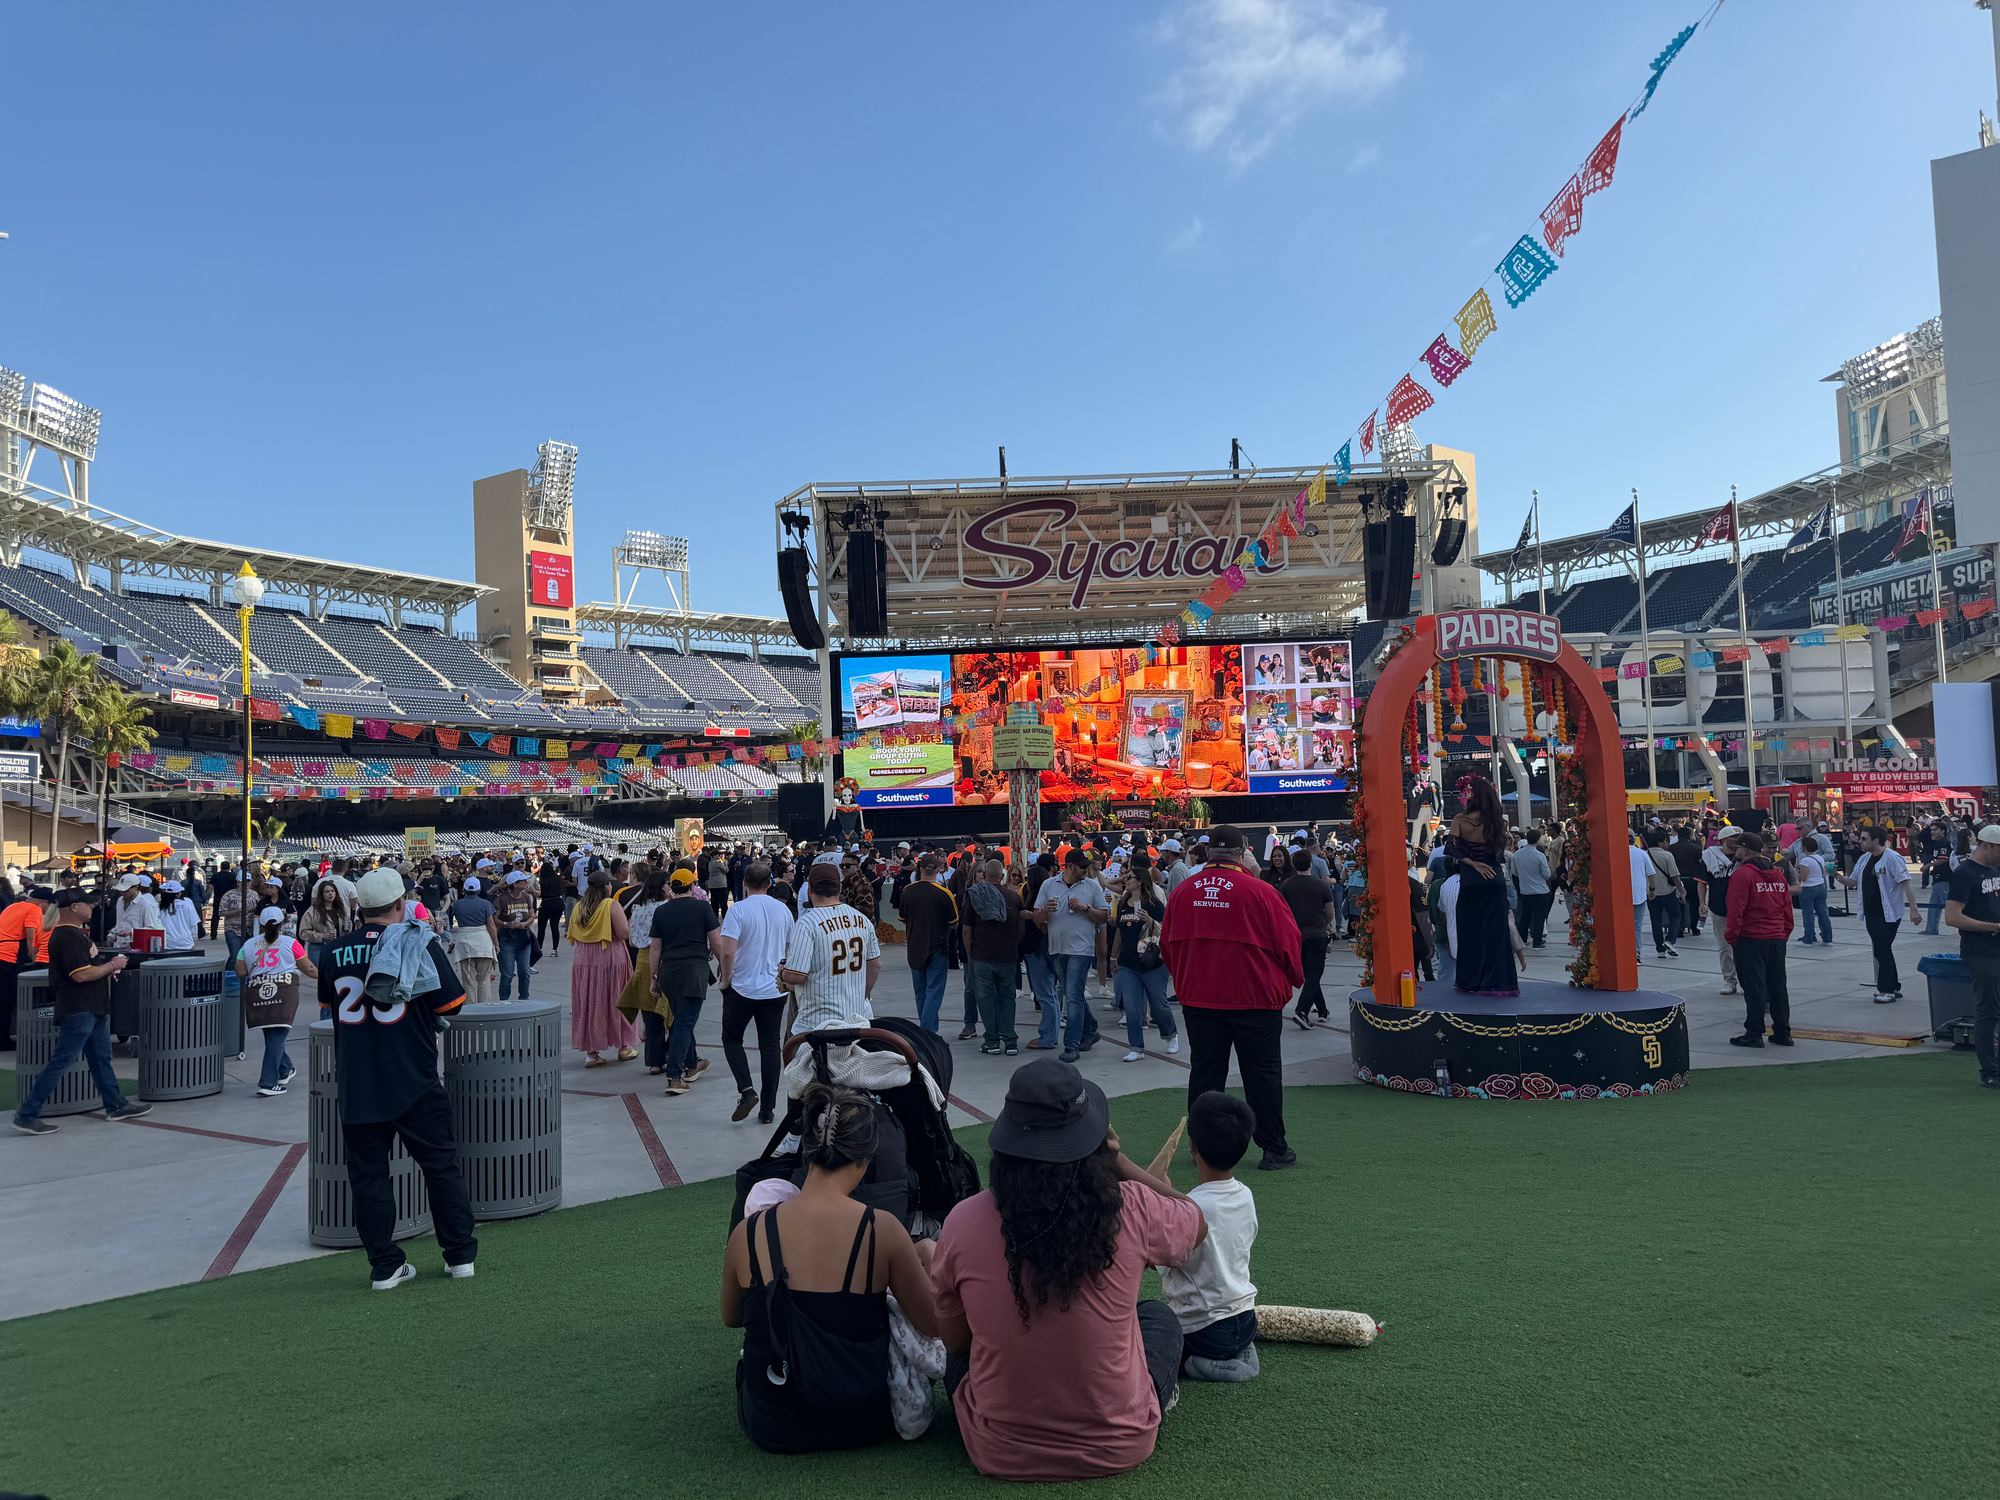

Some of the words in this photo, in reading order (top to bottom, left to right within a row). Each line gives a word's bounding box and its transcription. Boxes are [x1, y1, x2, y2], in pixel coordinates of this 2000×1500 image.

[961, 498, 1287, 612] Sycuan
[1812, 585, 1883, 620] WESTERN
[1890, 571, 1948, 603] METAL
[1439, 613, 1559, 654] PADRES
[1830, 757, 1870, 772] THE
[870, 768, 926, 776] PADRES.COM/GROUPS
[1852, 773, 1867, 781] BY
[1869, 772, 1935, 781] BUDWEISER
[1279, 778, 1326, 788] Southwest
[1894, 784, 1908, 792] YOU,
[876, 792, 924, 803] Southwest
[1795, 799, 1808, 808] THIS
[1117, 809, 1151, 819] PADRES
[1194, 876, 1234, 891] ELITE
[1756, 881, 1786, 893] ELITE
[1193, 900, 1230, 909] SERVICES
[818, 915, 851, 934] TATIS
[853, 914, 867, 930] JR.
[255, 947, 280, 968] 13
[831, 936, 864, 977] 23
[253, 999, 283, 1007] BASEBALL
